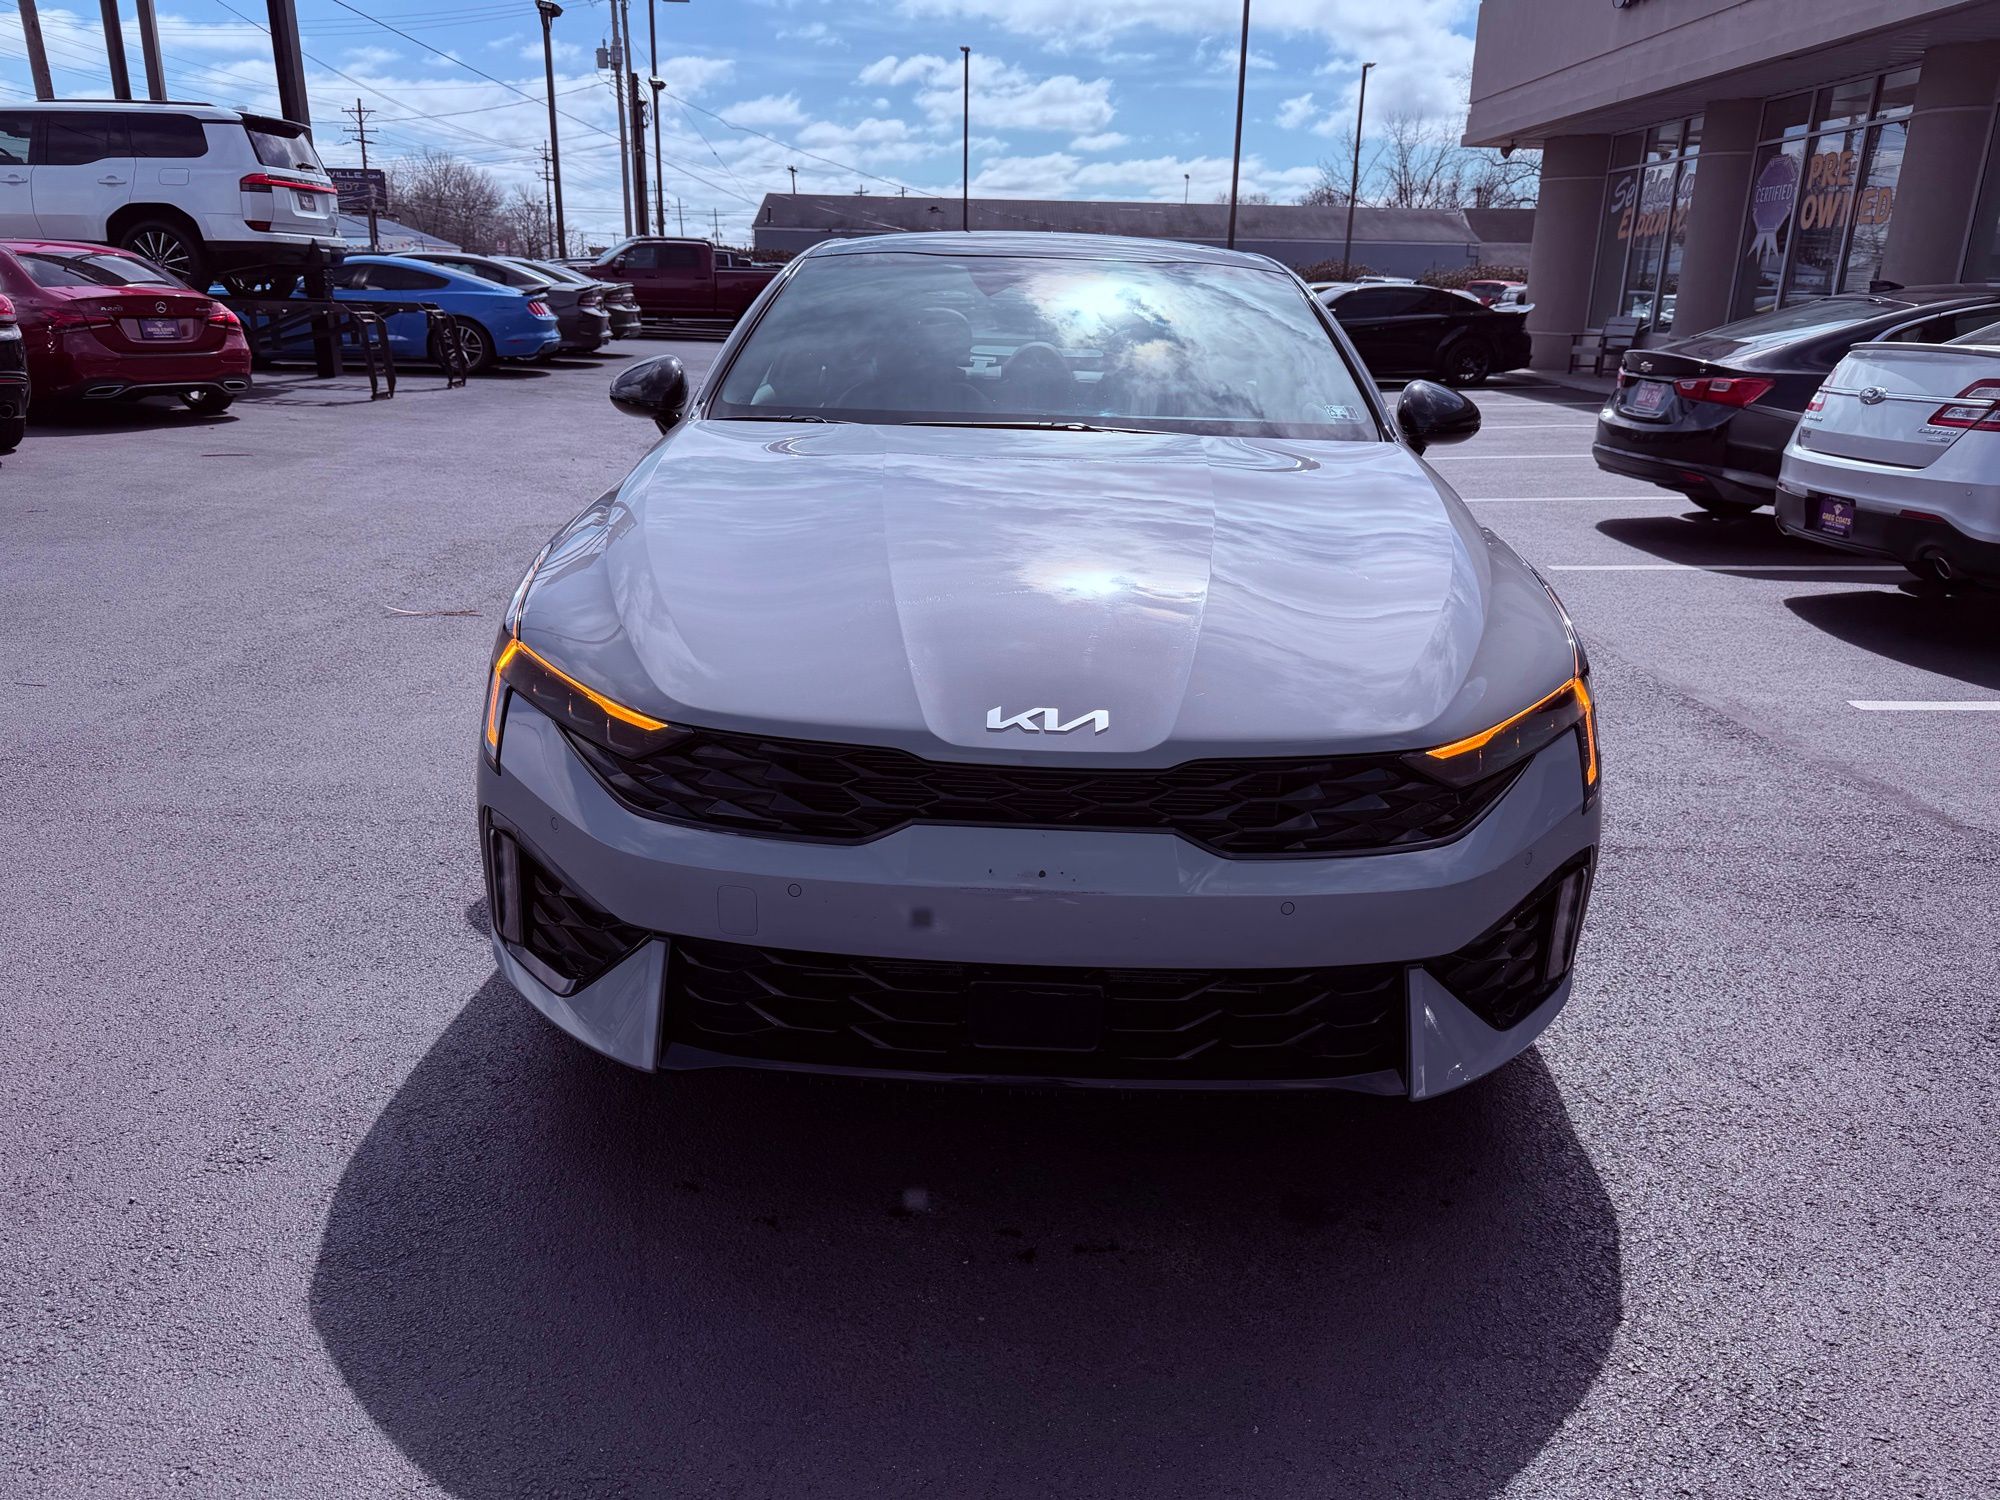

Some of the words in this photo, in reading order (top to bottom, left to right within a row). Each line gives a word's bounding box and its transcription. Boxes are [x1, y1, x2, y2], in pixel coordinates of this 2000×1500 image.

[1806, 149, 1855, 190] PRE
[1611, 176, 1637, 214] Se
[1756, 183, 1794, 203] CERTIFIED
[986, 705, 1109, 735] KIA
